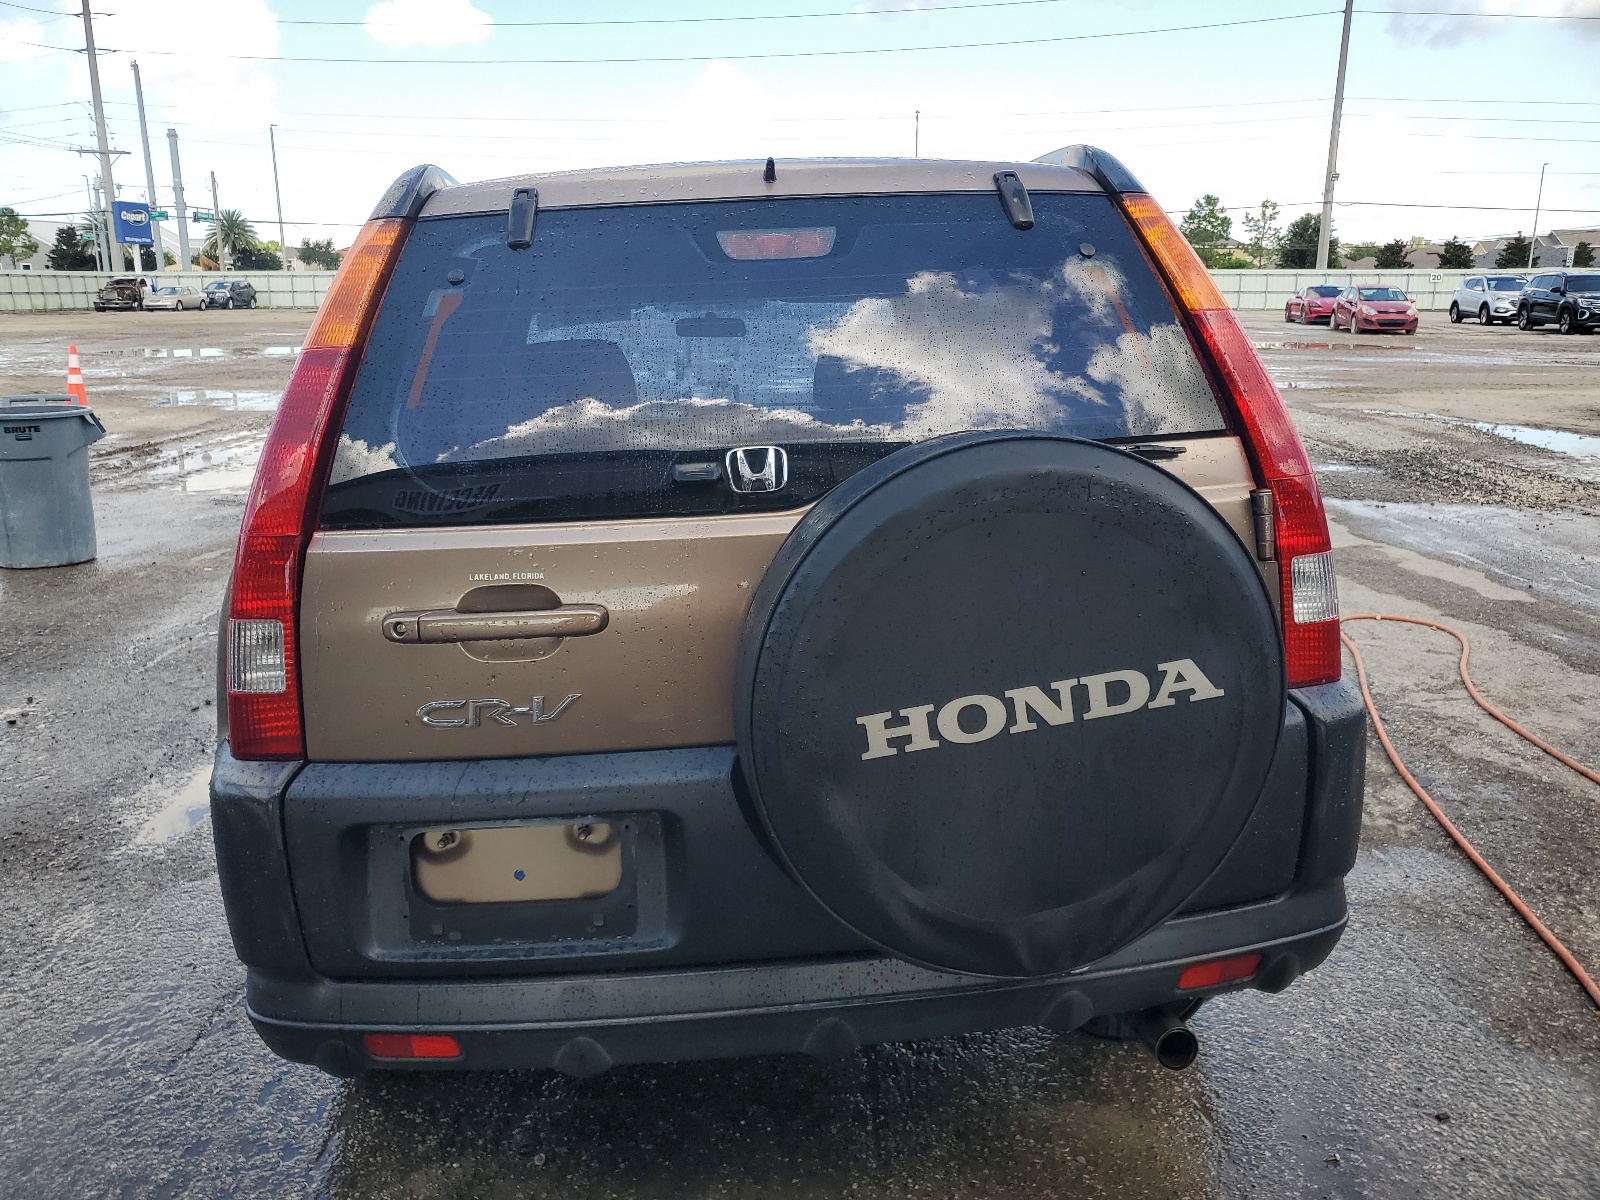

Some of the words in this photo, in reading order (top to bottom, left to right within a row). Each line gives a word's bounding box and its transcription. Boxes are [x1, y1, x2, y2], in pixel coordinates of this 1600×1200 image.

[121, 210, 146, 221] Copart
[3, 425, 41, 434] BRUTE
[513, 572, 545, 580] FLORIDA
[416, 693, 583, 729] CR-V
[856, 658, 1225, 761] HONDA
